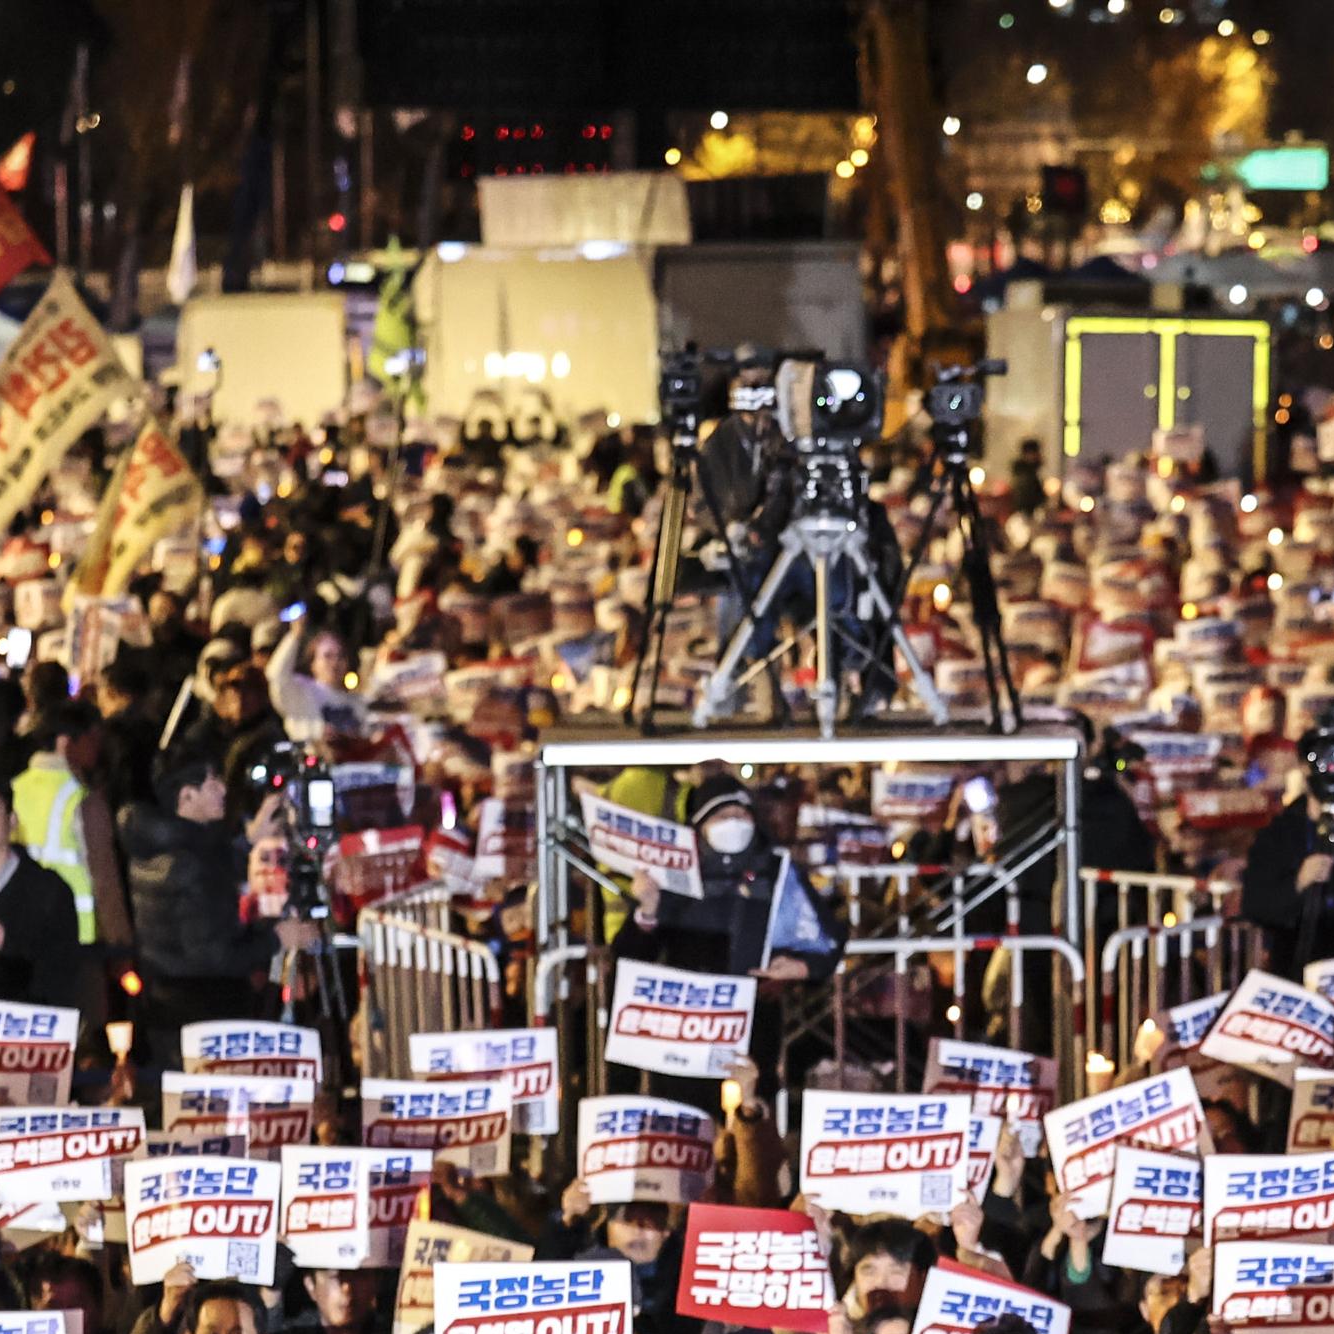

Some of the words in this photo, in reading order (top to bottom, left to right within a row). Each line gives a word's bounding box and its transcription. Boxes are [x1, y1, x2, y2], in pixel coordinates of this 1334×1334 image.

[634, 976, 739, 1009] 국정농단
[682, 1011, 745, 1043] OUT!
[3, 1043, 67, 1071] OUT!
[200, 1031, 301, 1057] 국정농단
[388, 1087, 492, 1120] 국정농단
[823, 1103, 948, 1135] 국정농단
[1065, 1081, 1173, 1142] 국정농단
[0, 1112, 121, 1134] 국정농단
[596, 1106, 701, 1135] 국정농단
[66, 1127, 137, 1160] OUT!
[808, 1141, 890, 1175] 윤석열
[890, 1133, 962, 1169] OUT!
[140, 1166, 259, 1202] 국정농단
[195, 1206, 269, 1237] OUT!
[695, 1231, 827, 1270] 국정농단
[457, 1270, 605, 1312] 국정농단
[689, 1271, 837, 1311] 규명하라
[1222, 1293, 1302, 1320] 윤석열
